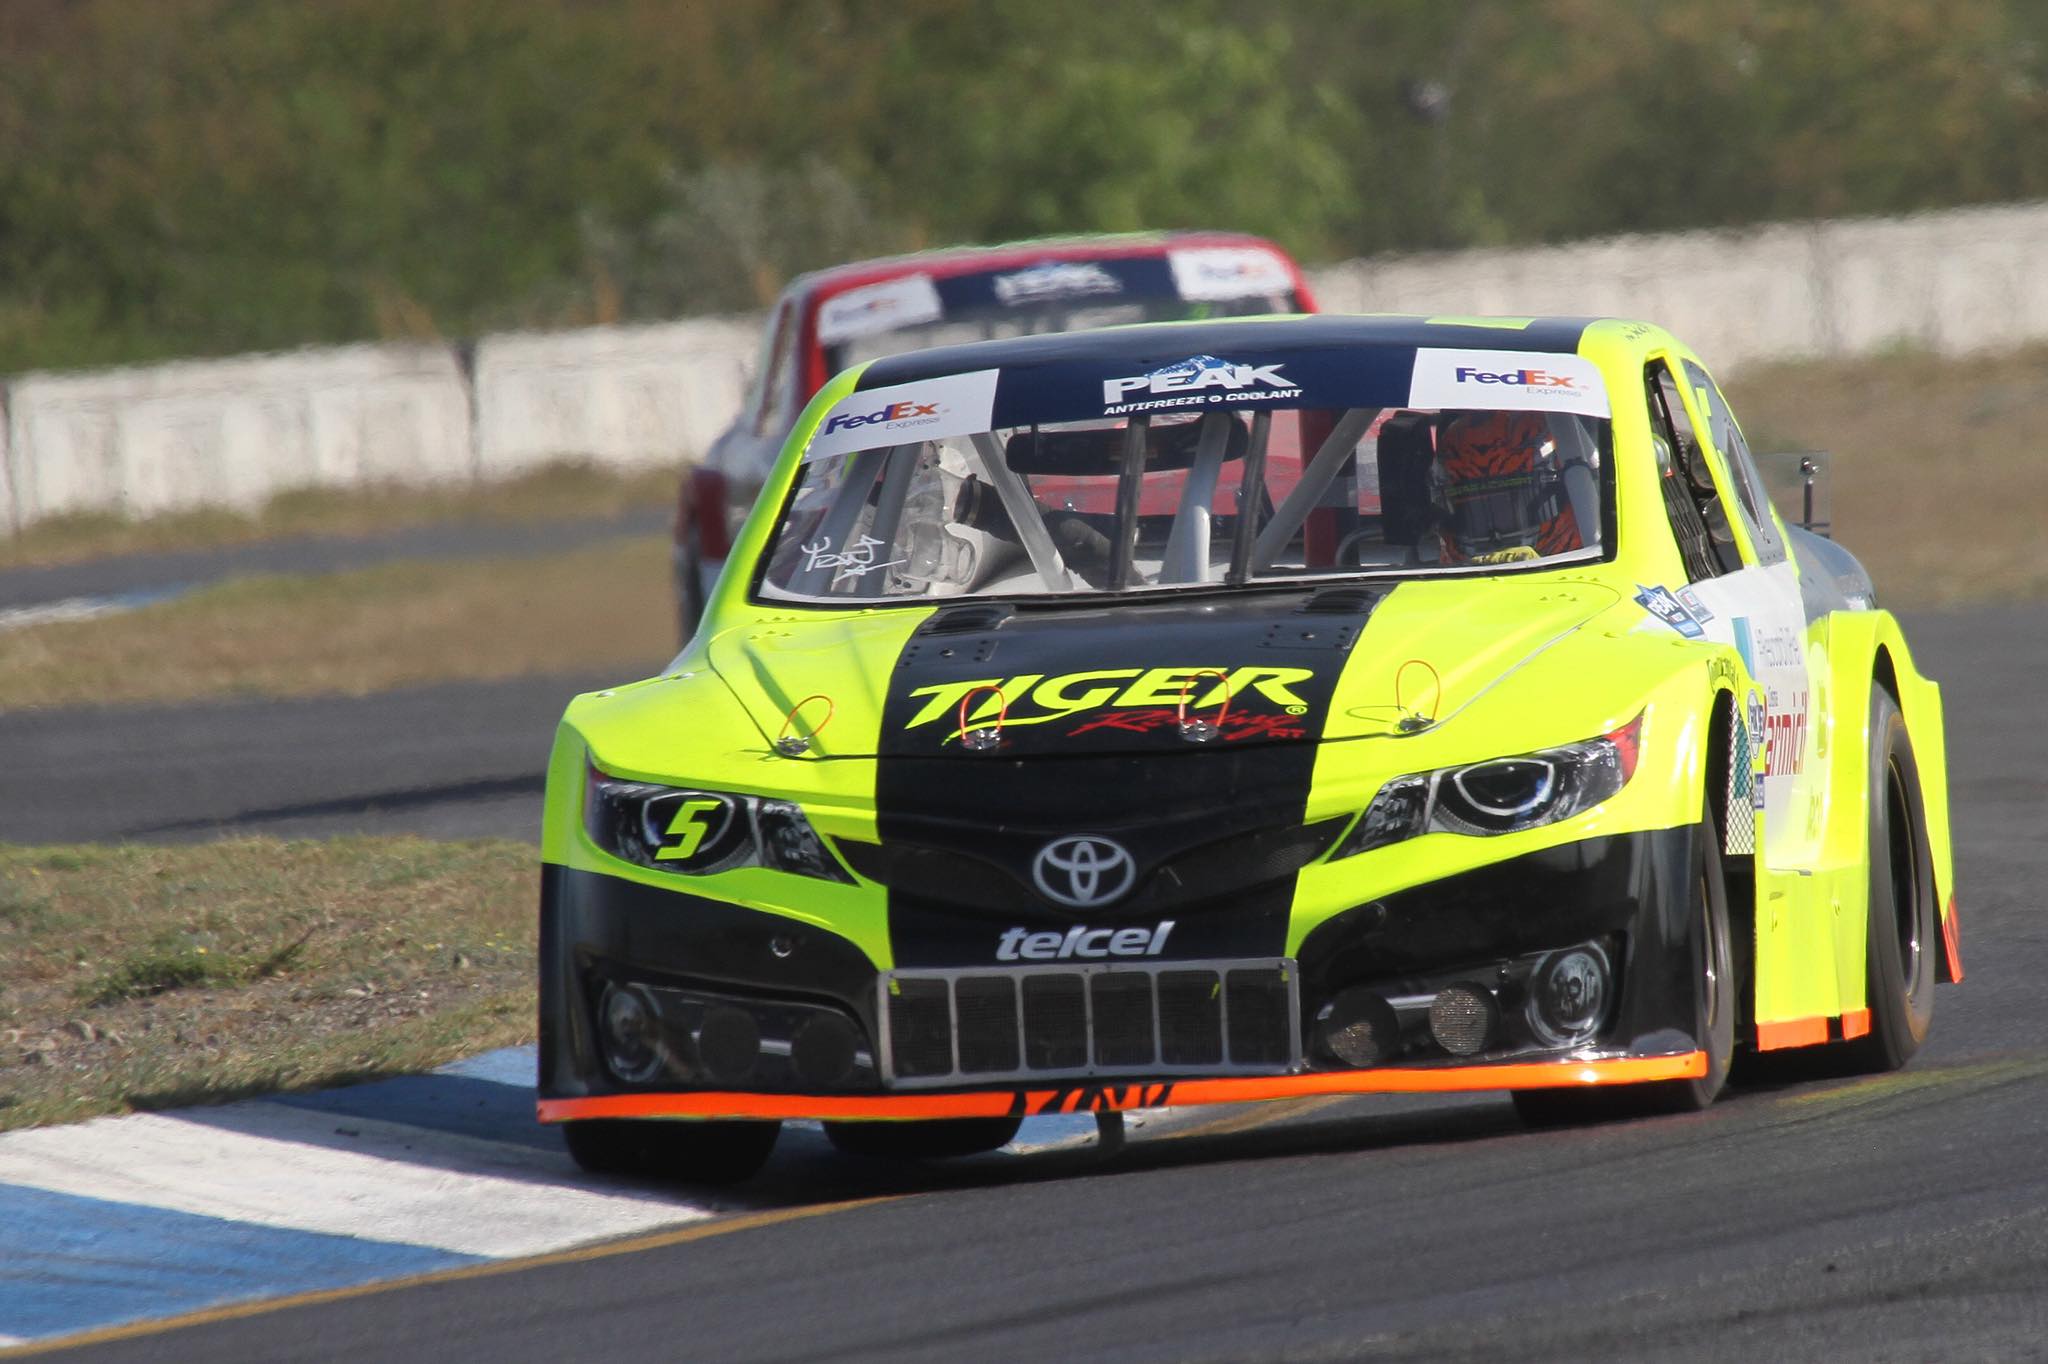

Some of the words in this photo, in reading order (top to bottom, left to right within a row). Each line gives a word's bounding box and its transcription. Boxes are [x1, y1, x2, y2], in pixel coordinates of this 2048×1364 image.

[1103, 363, 1298, 405] PEAK
[1455, 367, 1575, 388] FedEx
[1526, 386, 1582, 397] Express
[824, 401, 940, 435] FedEx
[1103, 395, 1206, 416] ANTIFREEZE
[1225, 389, 1303, 402] COOLANT
[885, 417, 941, 431] Express
[905, 666, 1314, 747] TIGER
[655, 800, 723, 861] 5
[996, 920, 1177, 961] telcel
